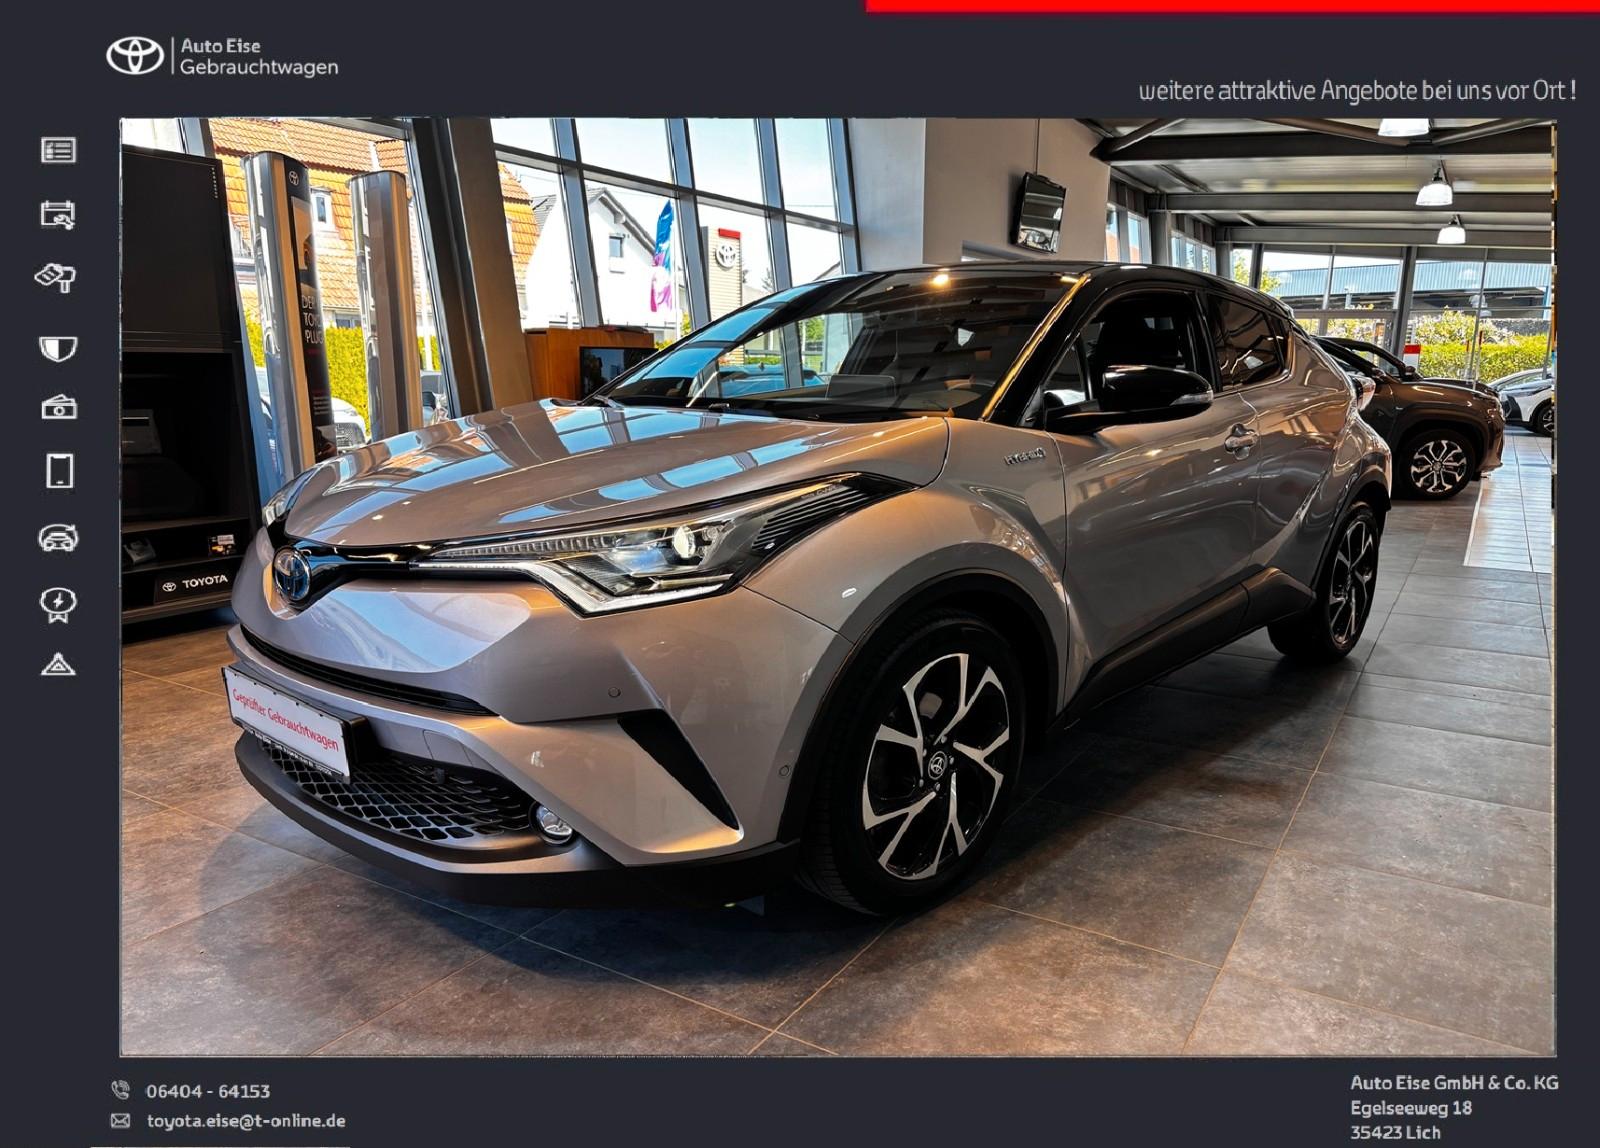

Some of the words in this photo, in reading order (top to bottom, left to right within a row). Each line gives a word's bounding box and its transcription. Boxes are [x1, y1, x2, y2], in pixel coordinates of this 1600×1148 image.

[181, 574, 228, 589] TOYOTA
[232, 688, 267, 717] Geprüfter
[267, 707, 339, 752] Gebrauchtwagen
